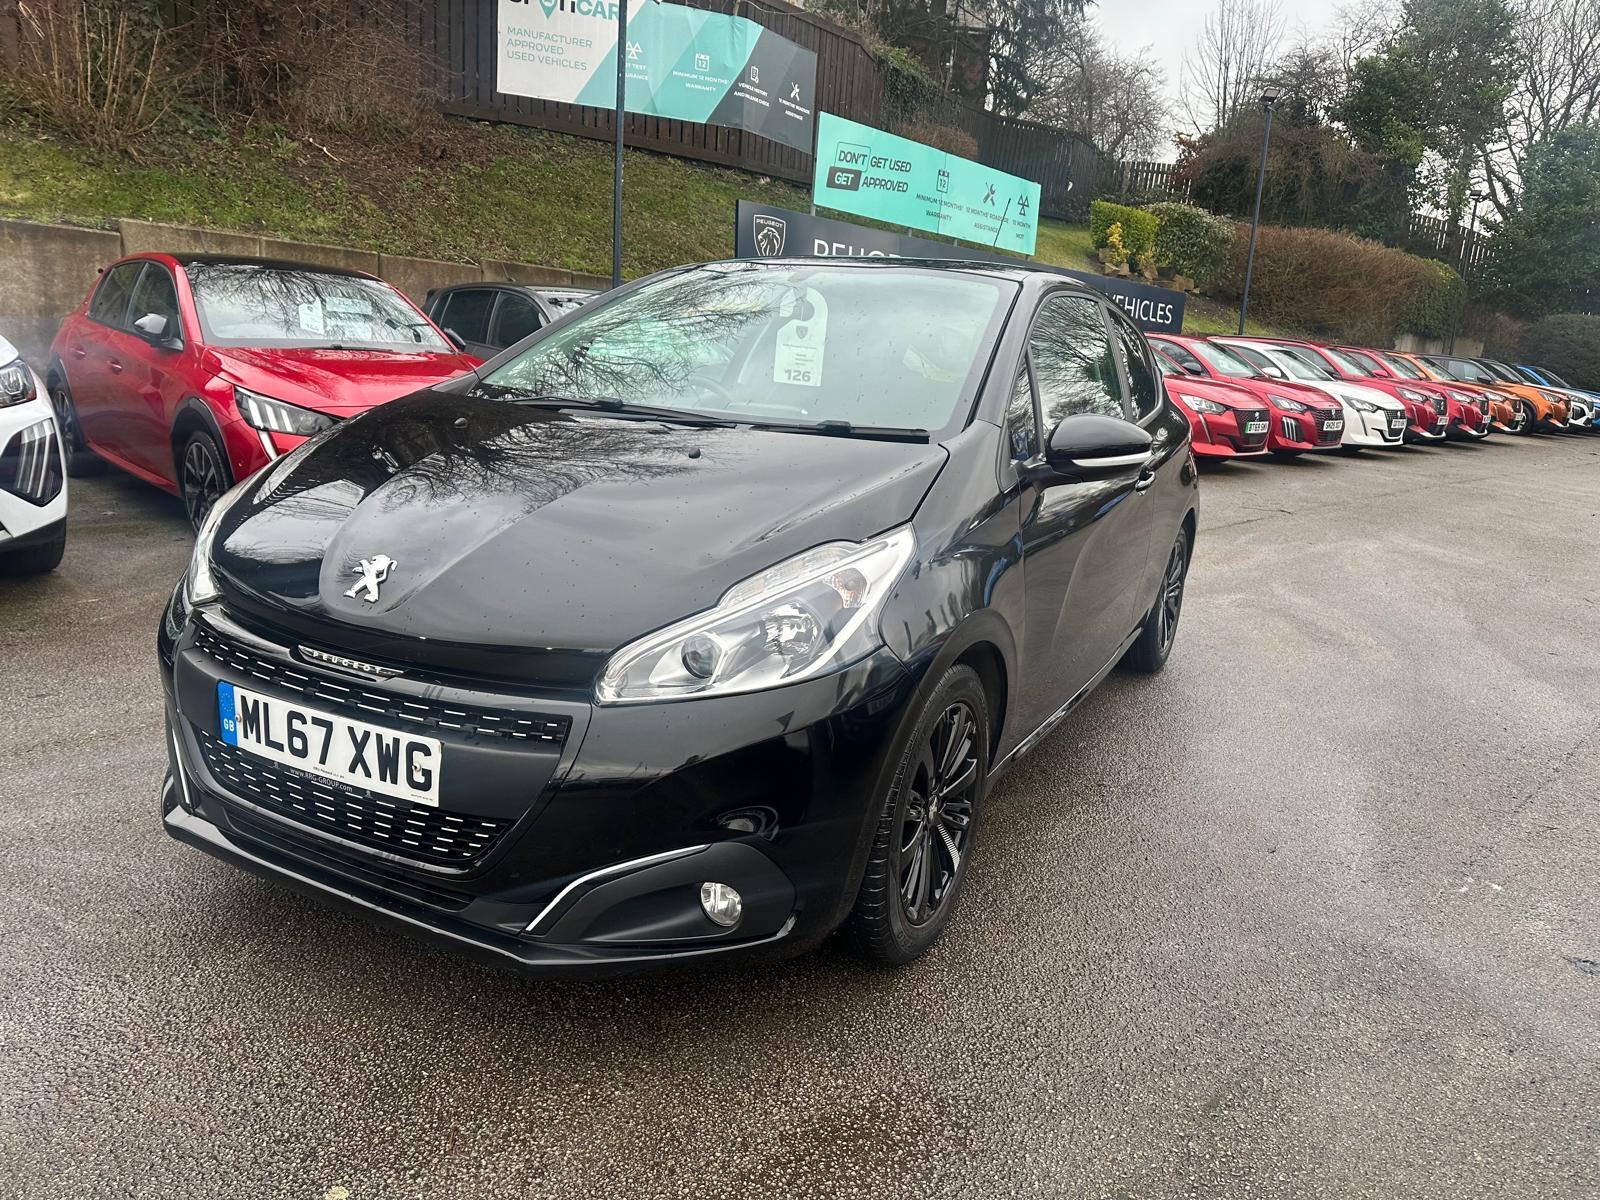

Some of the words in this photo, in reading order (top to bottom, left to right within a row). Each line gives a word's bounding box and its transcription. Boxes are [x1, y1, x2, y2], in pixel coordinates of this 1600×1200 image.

[507, 25, 592, 48] MANUFACTURER
[507, 38, 564, 55] APPROVED
[507, 50, 535, 62] USED
[538, 55, 587, 71] VEHICLES
[685, 82, 716, 91] WARRANTY
[838, 150, 867, 165] DON'T
[870, 156, 888, 169] GET
[889, 158, 912, 173] USED
[834, 171, 854, 186] GET
[861, 176, 909, 193] APPROVED
[916, 193, 938, 205] MINIMUM
[756, 218, 783, 228] PEUGEOT
[925, 209, 952, 222] WARRANTY
[1112, 294, 1173, 324] HICLES
[784, 368, 811, 382] 126
[313, 650, 381, 673] PEUGEOT
[223, 717, 234, 732] GB
[240, 694, 334, 765] ML67
[347, 725, 432, 793] XWG
[290, 768, 353, 792] www.RRG-GROUP.com
